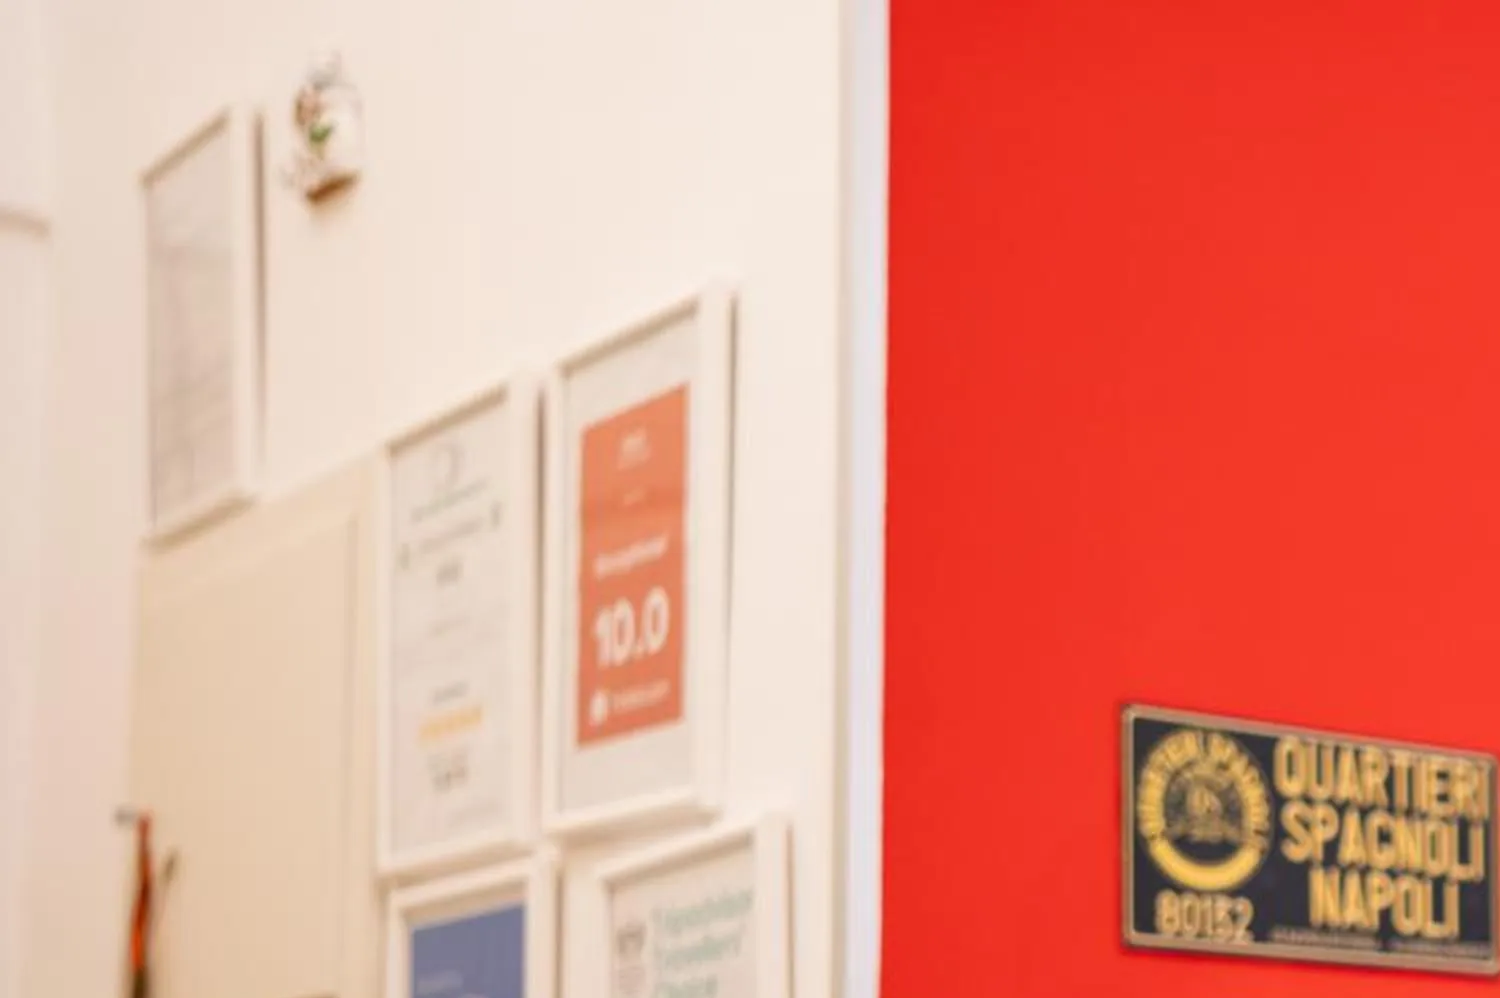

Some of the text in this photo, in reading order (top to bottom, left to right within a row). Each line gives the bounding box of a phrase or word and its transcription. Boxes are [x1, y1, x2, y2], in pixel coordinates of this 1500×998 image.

[591, 585, 671, 668] 10.0
[1273, 735, 1489, 818] QUARTIERI
[1309, 866, 1460, 938] NAPOLI
